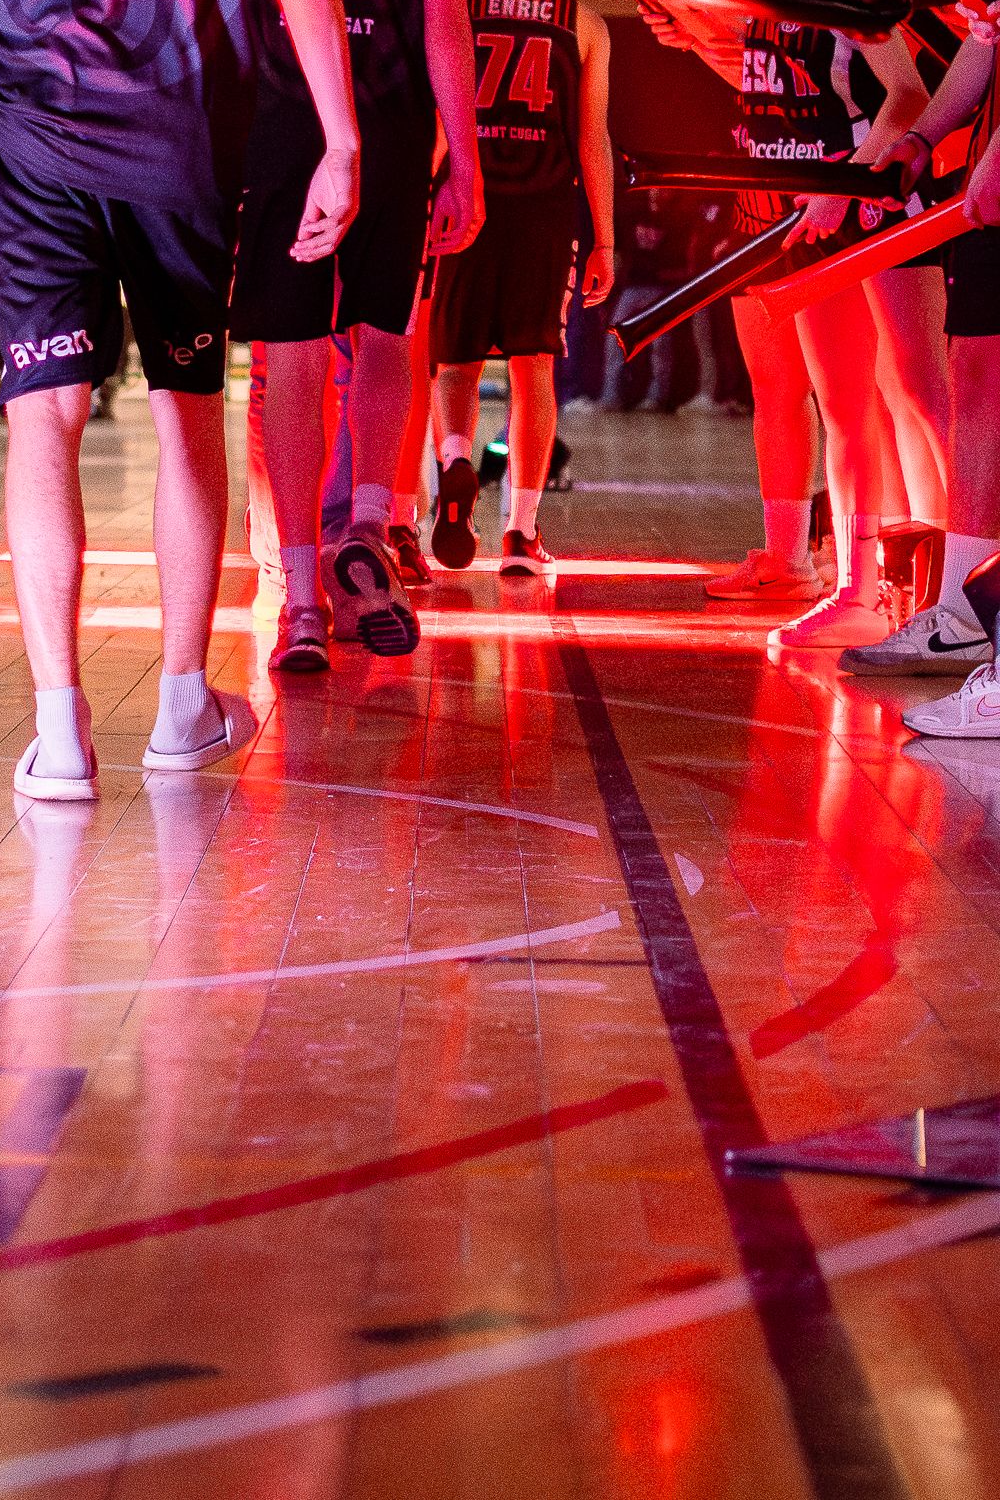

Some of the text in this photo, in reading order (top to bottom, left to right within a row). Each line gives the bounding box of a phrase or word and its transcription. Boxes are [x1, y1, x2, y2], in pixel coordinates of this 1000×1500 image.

[474, 33, 554, 112] 74
[476, 125, 547, 142] SANT CUGAT
